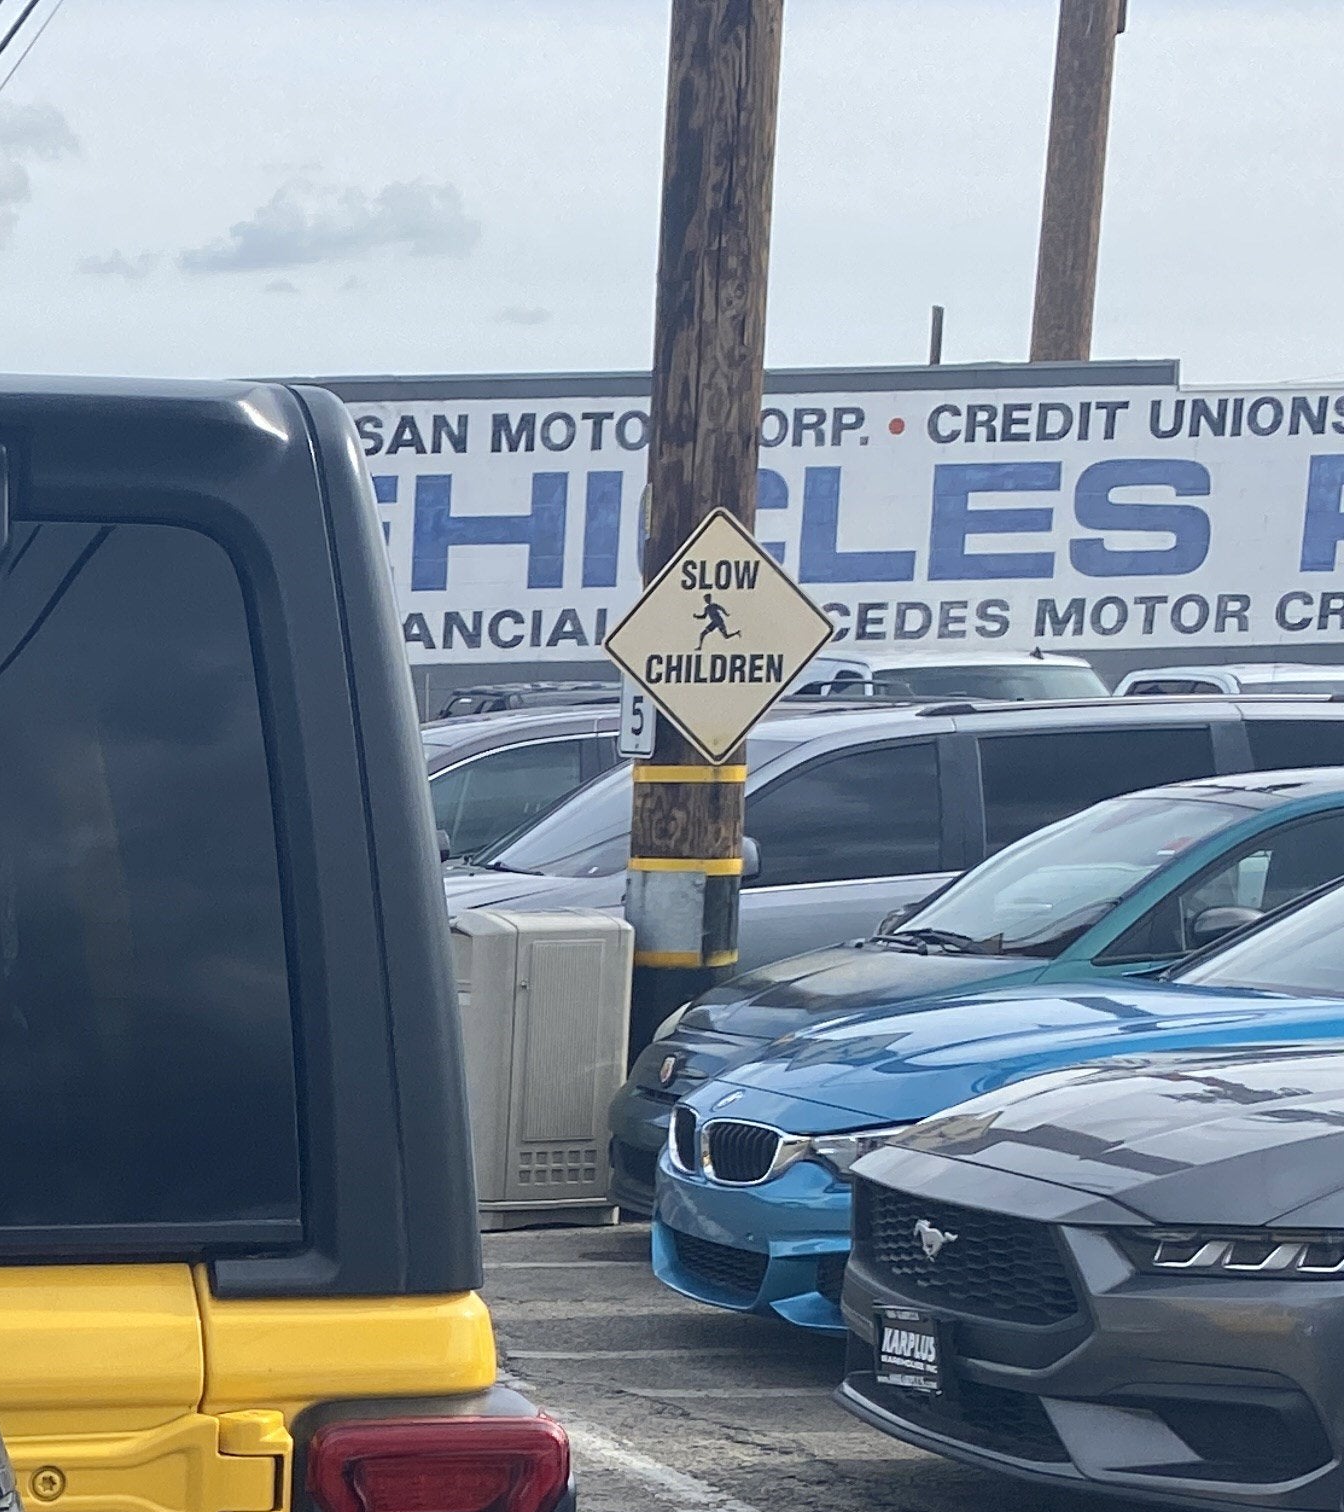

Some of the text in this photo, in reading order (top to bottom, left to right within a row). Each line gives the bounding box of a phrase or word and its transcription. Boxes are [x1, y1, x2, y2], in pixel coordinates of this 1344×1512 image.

[490, 410, 651, 453] MOTO
[758, 405, 870, 448] ORP.
[926, 400, 1130, 444] CREDIT
[680, 559, 761, 590] SLOW
[1033, 593, 1251, 638] MOTOR
[645, 653, 785, 684] CHILDREN
[881, 1326, 936, 1362] KARPLUS
